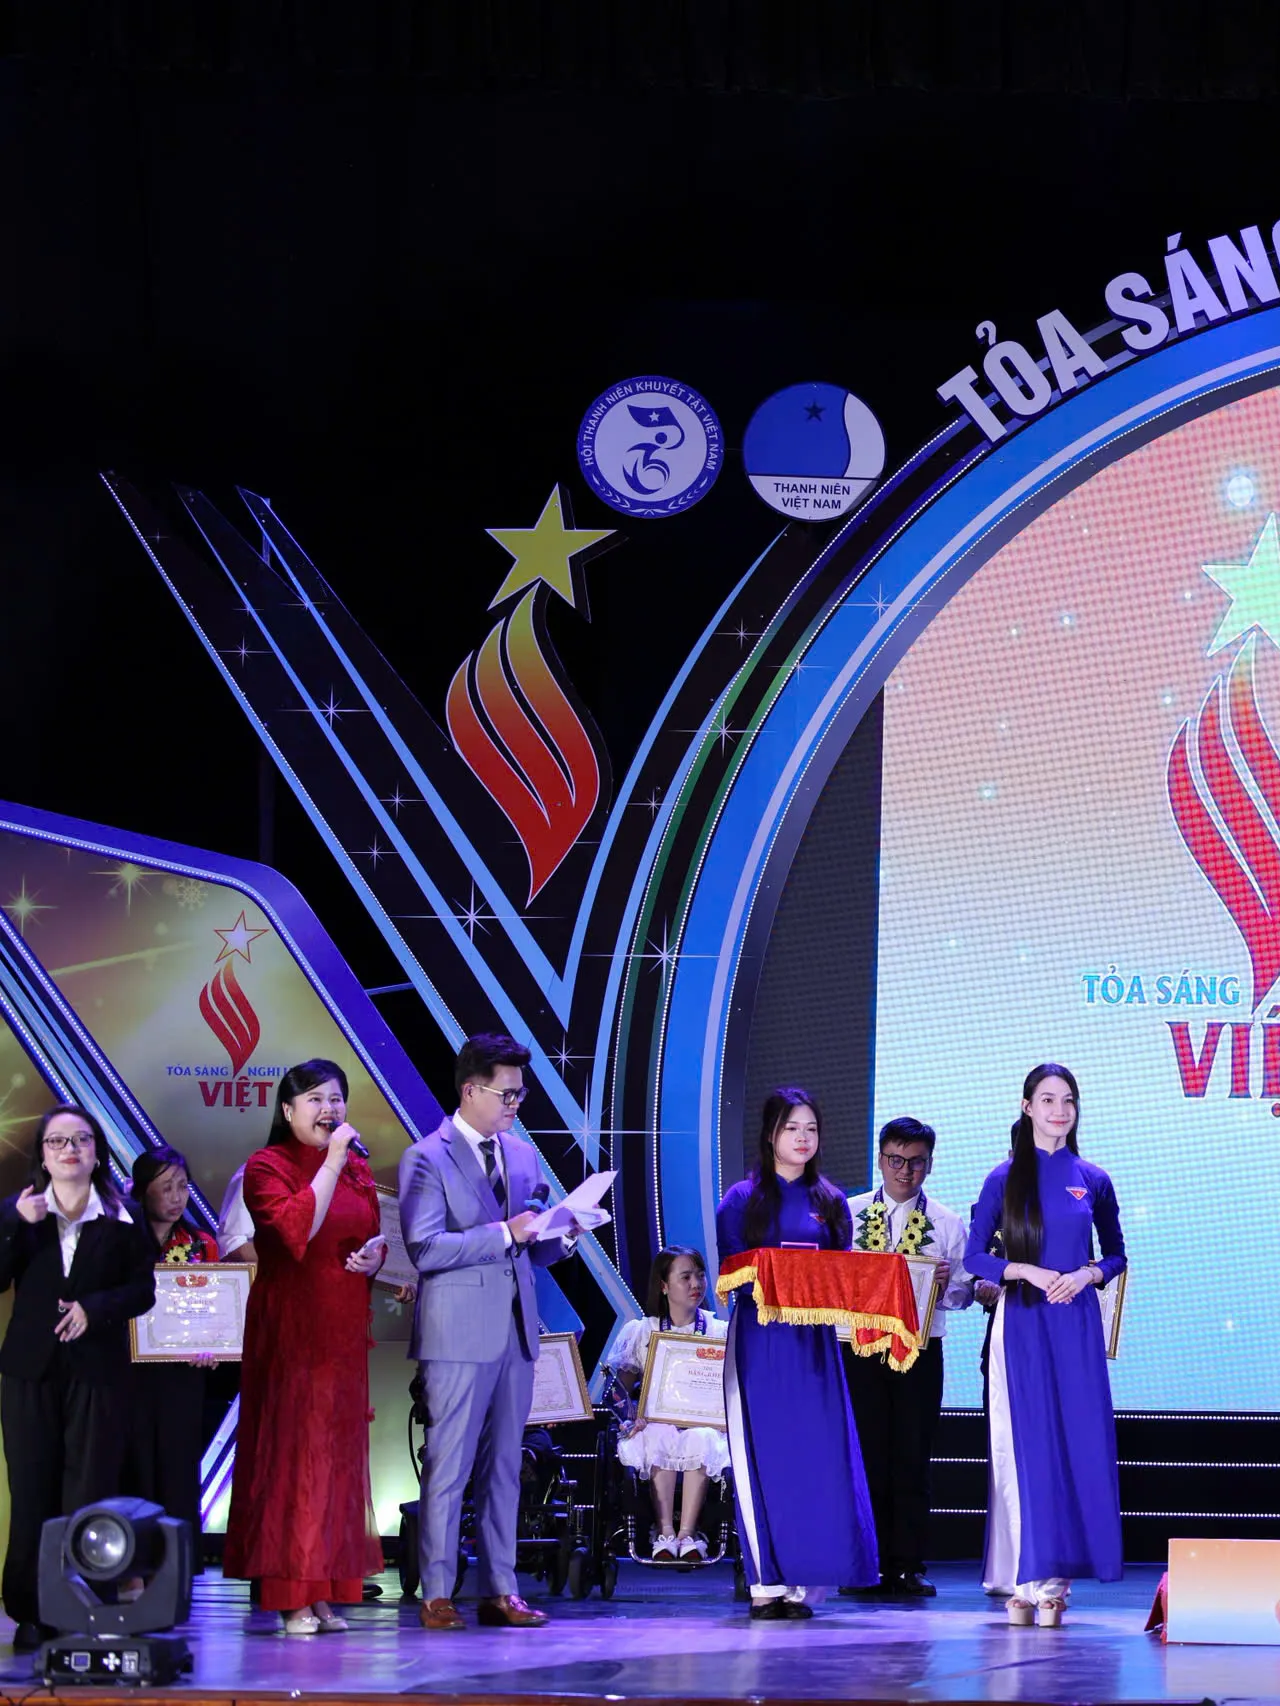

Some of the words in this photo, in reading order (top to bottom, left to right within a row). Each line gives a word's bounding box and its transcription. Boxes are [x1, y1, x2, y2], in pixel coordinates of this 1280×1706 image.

[936, 309, 1108, 443] TỎA
[607, 384, 633, 405] NIÊN
[636, 381, 686, 398] KHUYẾT
[687, 392, 707, 413] TẬT
[584, 403, 607, 442] THANH
[702, 414, 718, 441] VIỆT
[582, 445, 594, 466] HỘI
[706, 443, 719, 470] NAM
[773, 482, 816, 495] THANH
[821, 482, 850, 496] NIÊN
[782, 495, 810, 510] VIỆT
[813, 498, 842, 510] NAM
[1082, 965, 1146, 1005] TỎA
[1156, 969, 1241, 1006] SÁNG
[198, 1076, 274, 1113] VIỆT
